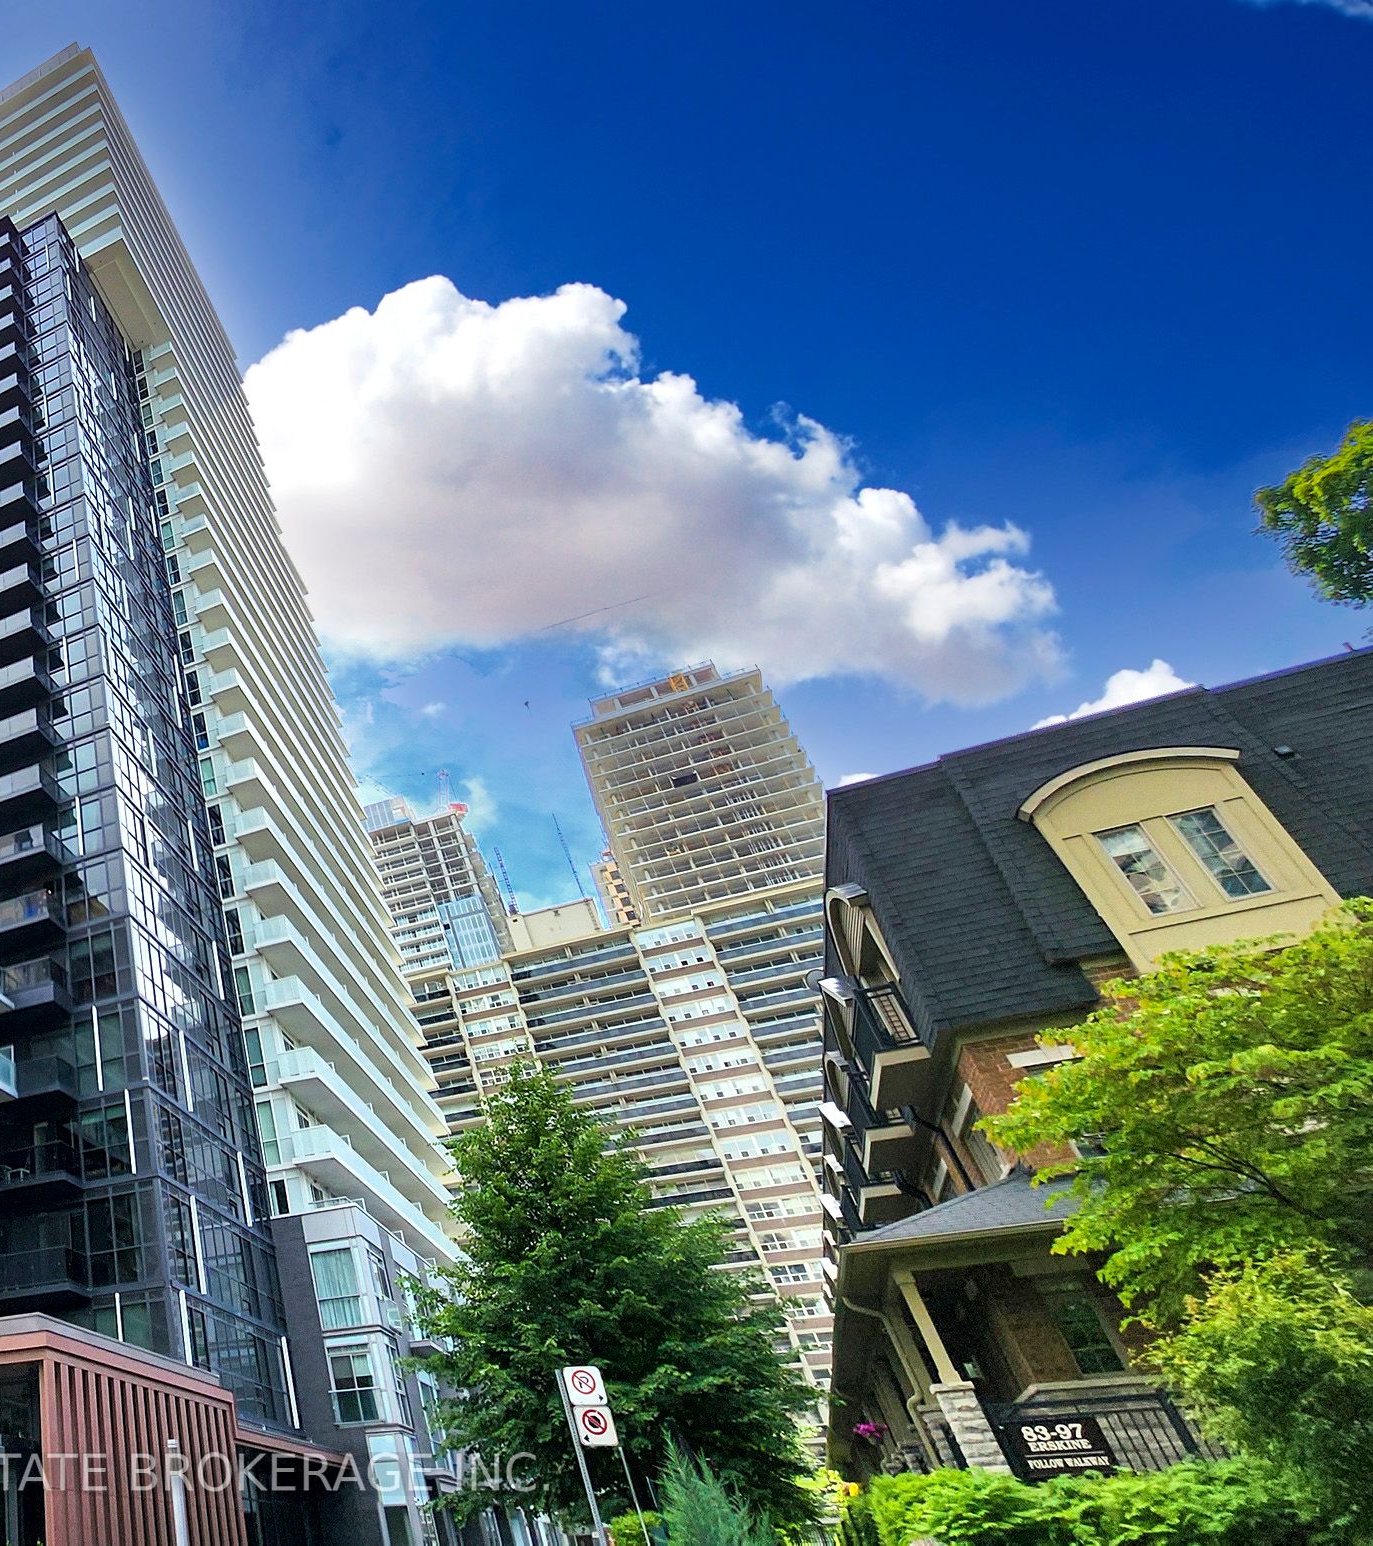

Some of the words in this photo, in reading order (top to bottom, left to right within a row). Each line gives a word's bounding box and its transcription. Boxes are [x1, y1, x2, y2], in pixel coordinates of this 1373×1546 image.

[1021, 1423, 1082, 1442] 83-97
[1028, 1439, 1092, 1452] ERSKINE
[1027, 1458, 1065, 1470] FOLLOW
[1065, 1456, 1110, 1467] WALKWAY
